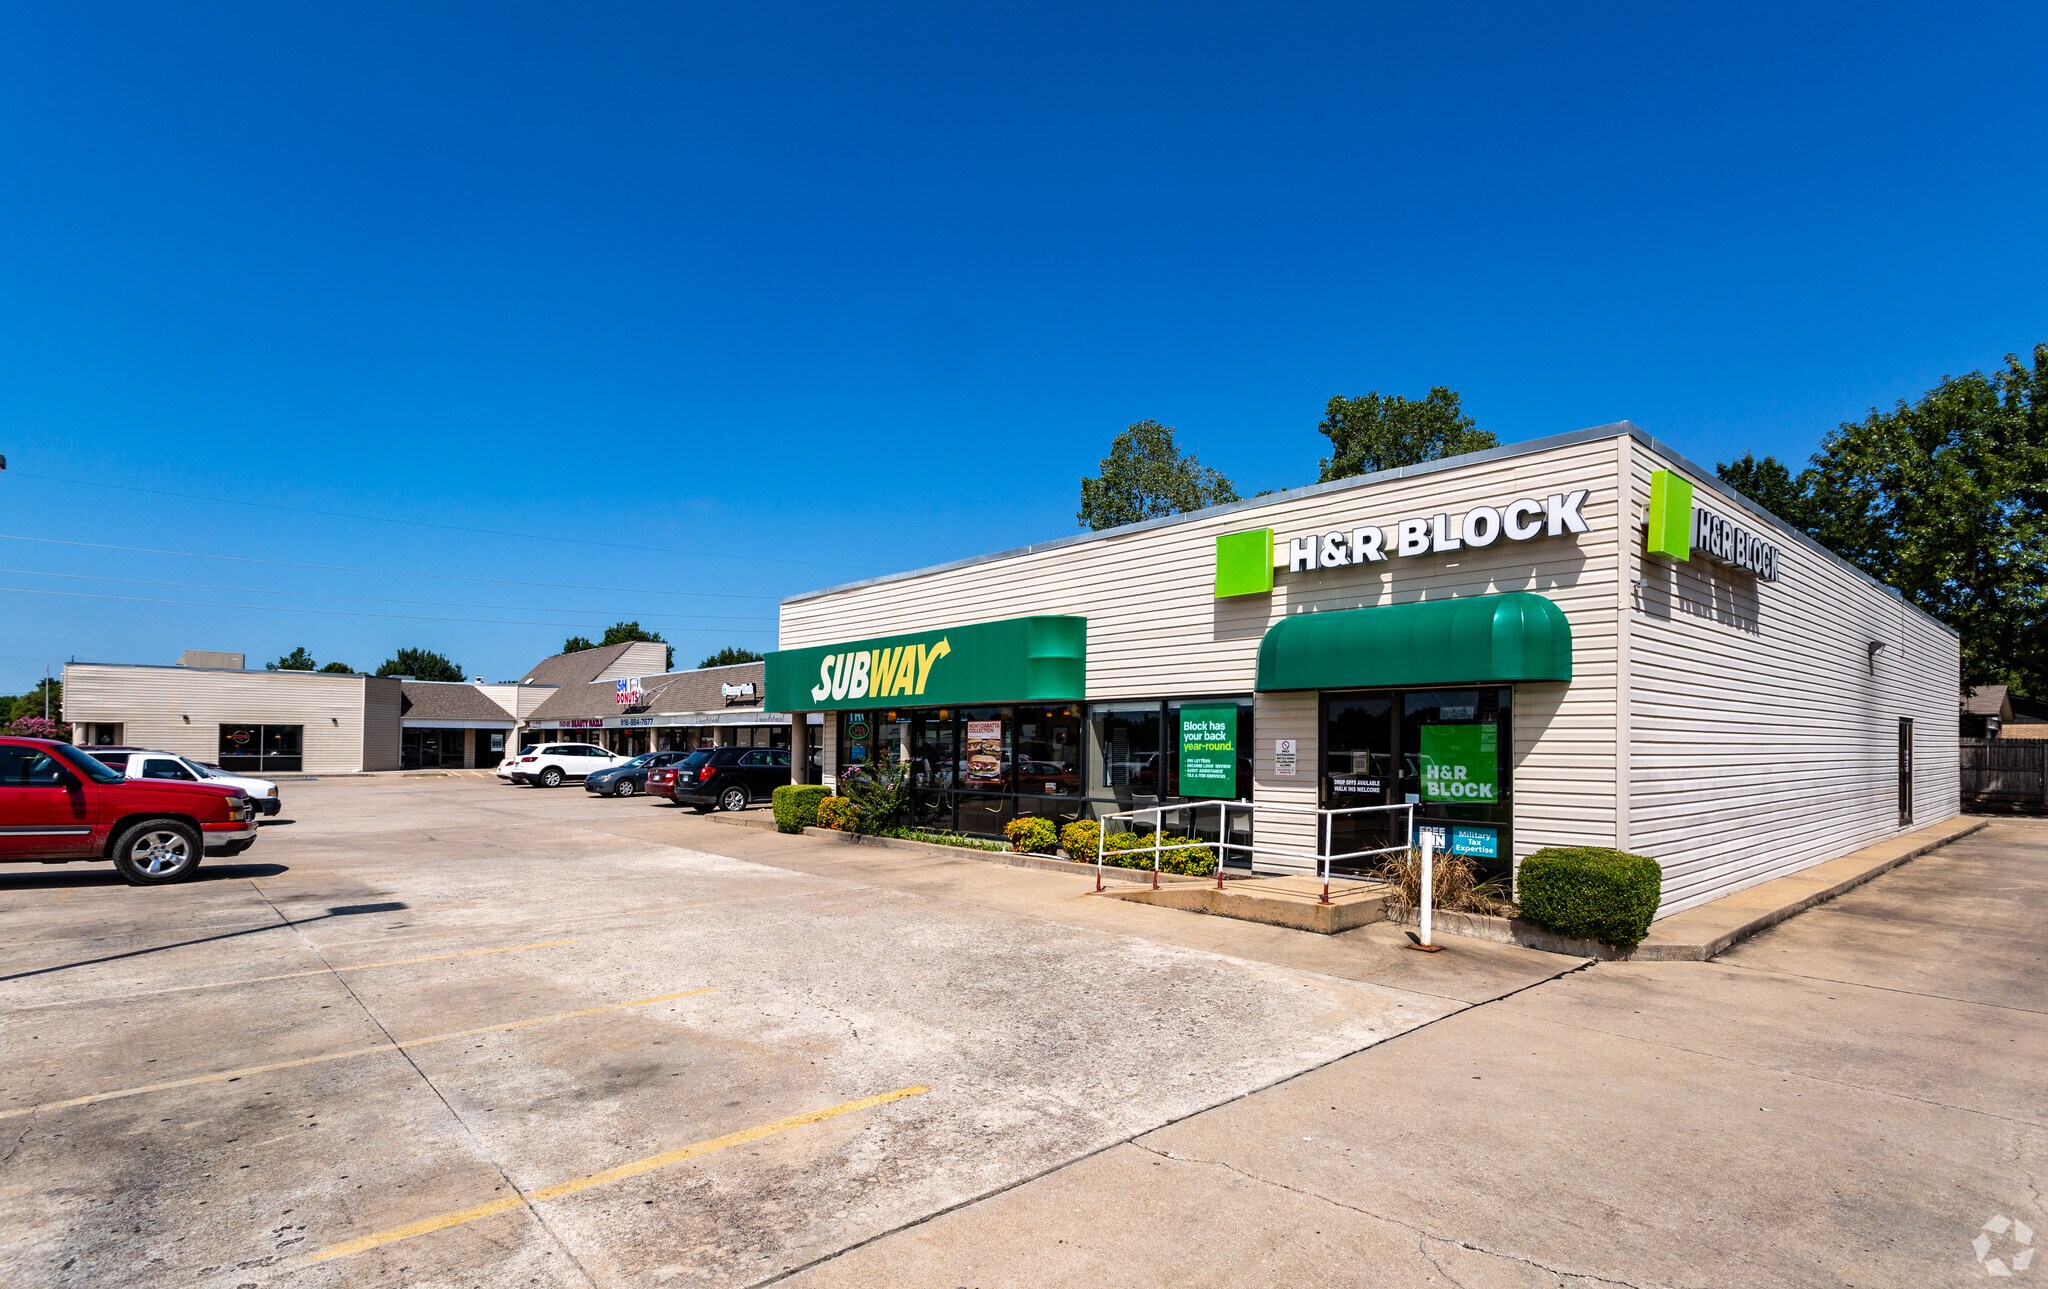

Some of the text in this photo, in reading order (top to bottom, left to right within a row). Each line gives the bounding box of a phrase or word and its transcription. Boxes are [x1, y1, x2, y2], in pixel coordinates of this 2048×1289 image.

[1289, 489, 1593, 573] H&R BLOCK
[1698, 508, 1780, 582] H&R BLOCK
[811, 636, 951, 704] SUBWAY
[616, 691, 639, 704] DONUTS
[1440, 706, 1474, 719] OPEN
[1184, 721, 1226, 731] Block has
[1184, 731, 1226, 743] your back
[1184, 741, 1234, 752] year-round.
[1426, 764, 1467, 780] H&R
[1427, 781, 1493, 798] BLOCK
[1458, 831, 1491, 841] Military
[1455, 844, 1494, 854] Expertise
